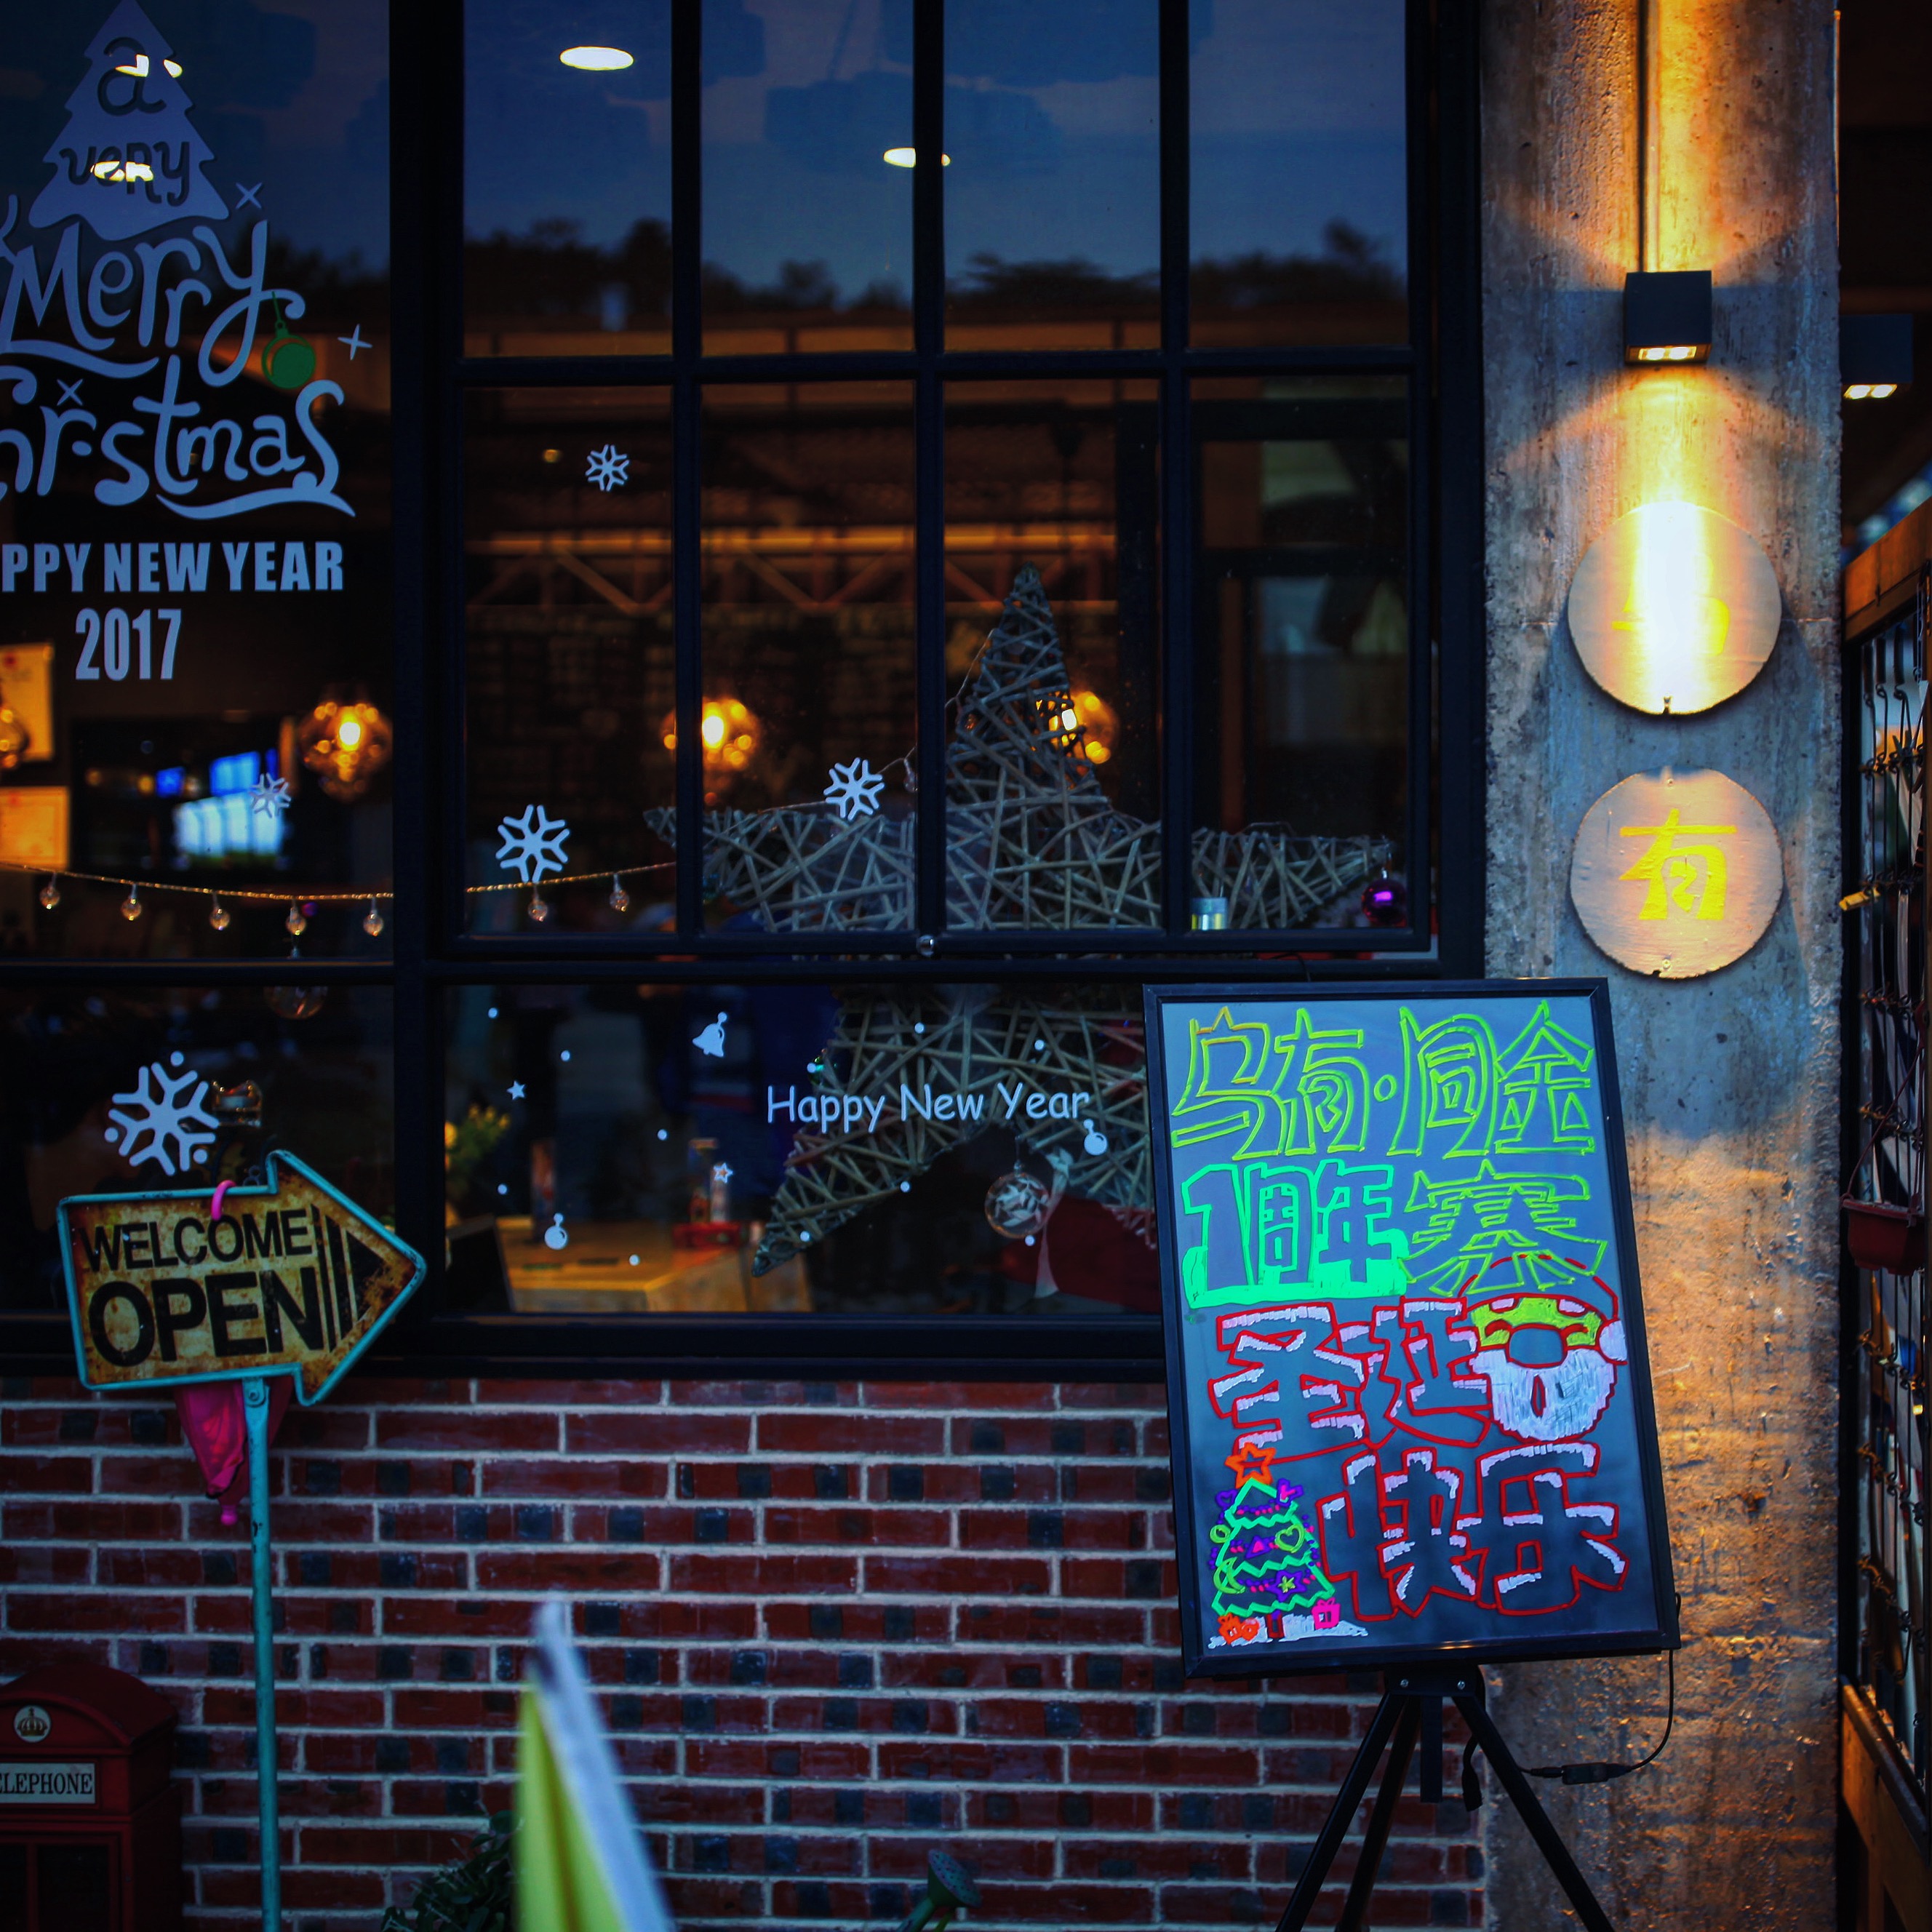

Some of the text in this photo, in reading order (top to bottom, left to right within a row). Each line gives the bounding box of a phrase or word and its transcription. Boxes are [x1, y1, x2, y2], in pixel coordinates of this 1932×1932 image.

[97, 36, 166, 116] a
[58, 141, 191, 207] very
[0, 220, 306, 388] Merry
[104, 543, 210, 592] NEW
[223, 541, 343, 591] YEAR
[75, 608, 182, 681] 2017
[767, 1082, 1090, 1133] Happy New Year
[79, 1209, 313, 1272] WELCOME
[88, 1266, 325, 1368] OPEN
[1316, 1440, 1629, 1622] 快乐
[0, 1772, 93, 1795] LEPHONE
